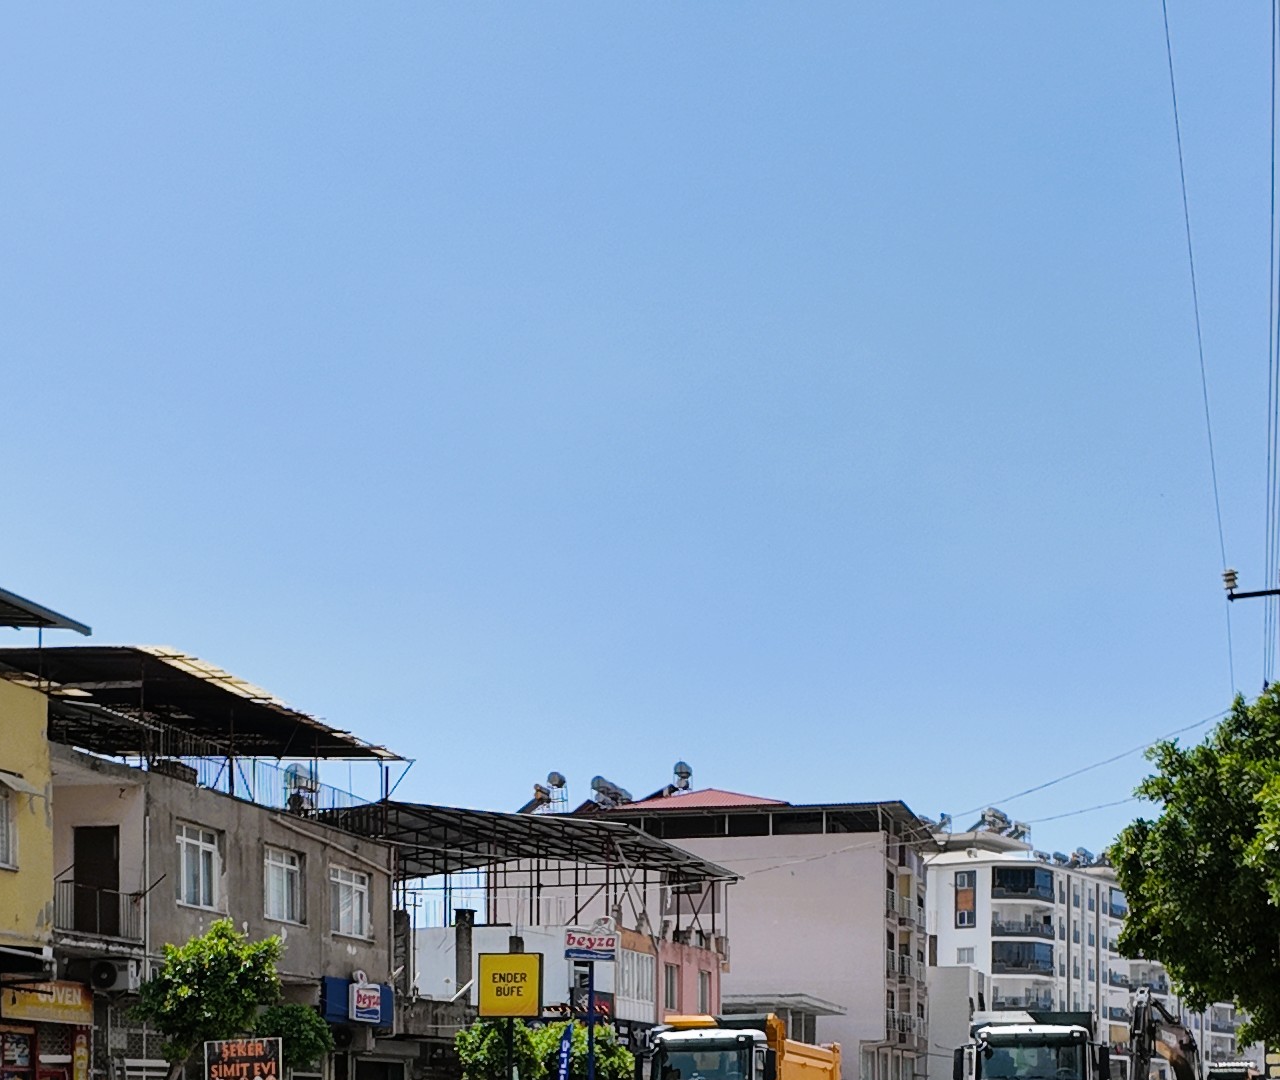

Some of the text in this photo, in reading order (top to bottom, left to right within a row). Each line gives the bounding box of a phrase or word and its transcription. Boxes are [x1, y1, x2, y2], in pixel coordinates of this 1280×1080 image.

[566, 933, 615, 949] beyza
[492, 972, 527, 983] ENDER
[496, 984, 524, 996] BÜFE
[221, 1041, 264, 1061] ŞEKER
[211, 1057, 276, 1078] SİMİT EVİ
